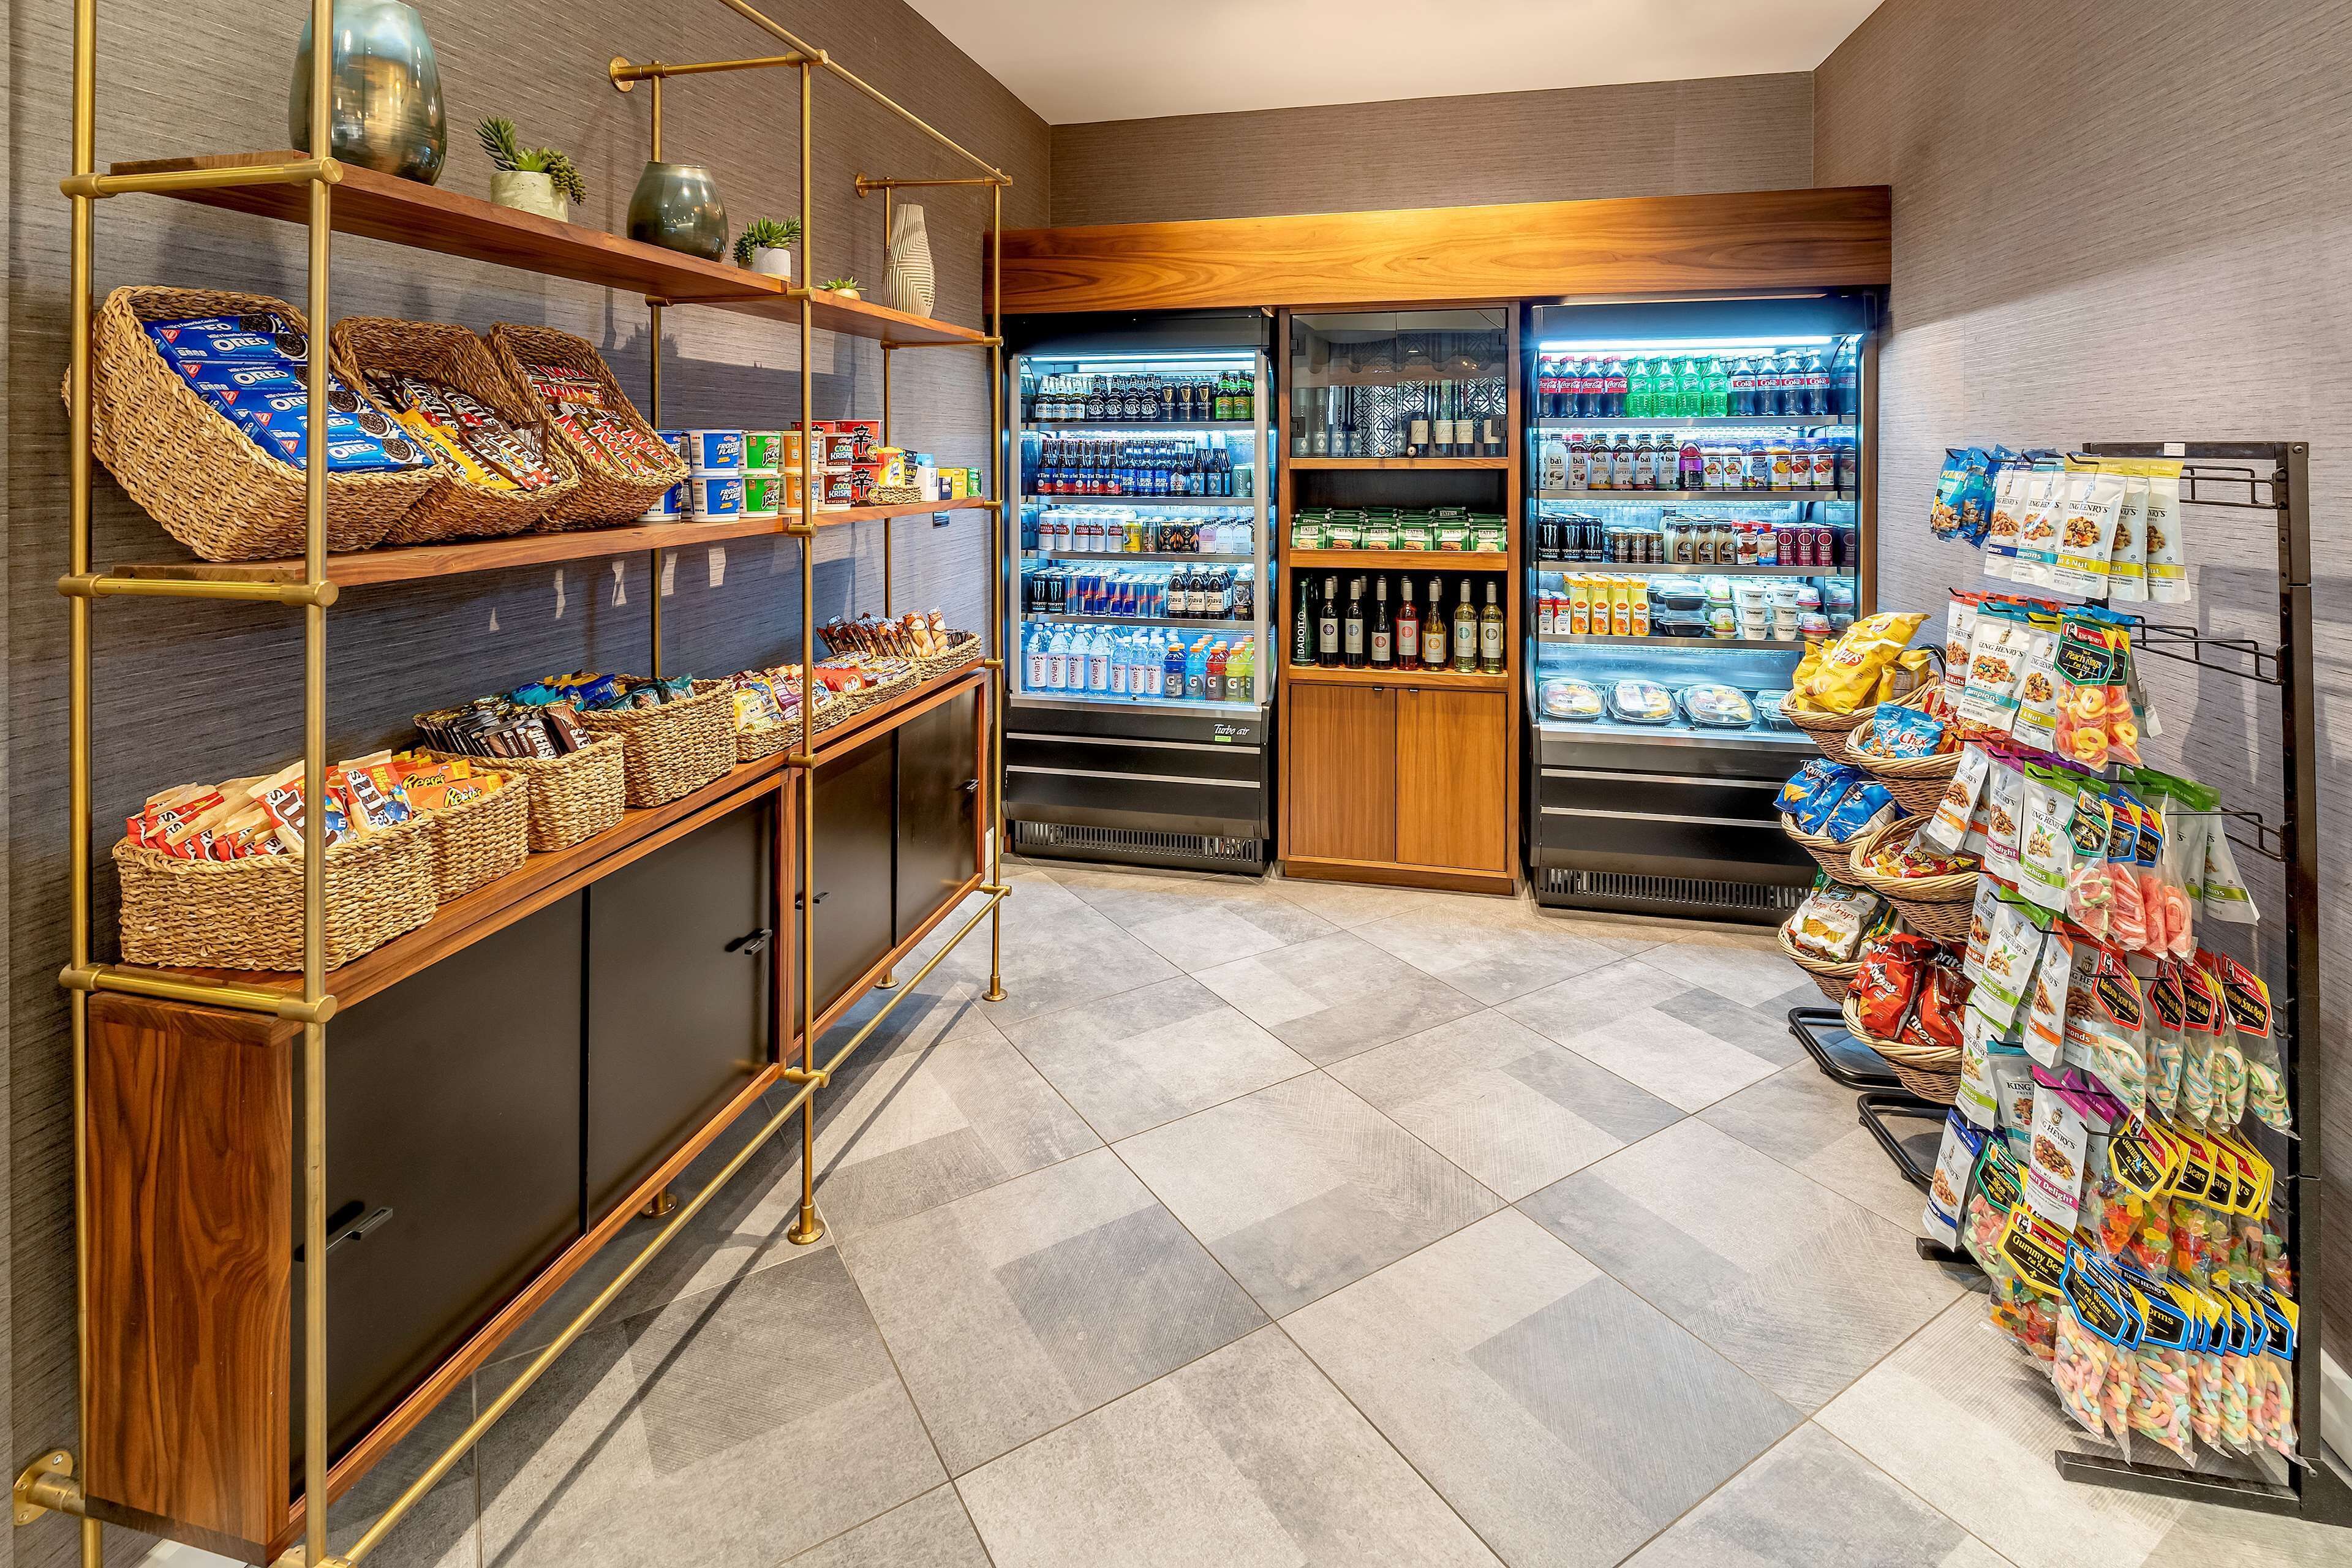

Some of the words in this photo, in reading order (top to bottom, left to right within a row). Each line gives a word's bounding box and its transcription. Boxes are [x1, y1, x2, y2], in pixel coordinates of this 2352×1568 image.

[213, 337, 270, 352] OREO
[233, 370, 289, 385] OREO
[1088, 404, 1104, 413] 805
[1107, 404, 1122, 413] 805
[1125, 404, 1140, 413] 805
[1141, 404, 1156, 412] 805
[853, 424, 873, 455] 辛
[328, 443, 379, 459] OREO
[589, 425, 638, 476] TWIX
[852, 468, 874, 499] 辛
[2071, 558, 2088, 569] Nut
[1995, 645, 2024, 658] HENRY'S
[2065, 650, 2086, 663] Peach
[2086, 655, 2103, 669] Rings
[1950, 676, 1965, 685] Nuts
[2027, 713, 2041, 722] Nut
[1214, 724, 1236, 735] Turbo
[1899, 732, 1929, 747] Chex
[1829, 902, 1857, 921] Crisps
[1971, 952, 1984, 962] Mix
[2082, 962, 2092, 971] KH
[2100, 978, 2117, 1001] Rainbow
[2117, 992, 2128, 1008] Sour
[2128, 1000, 2139, 1017] Belts
[2198, 1000, 2209, 1017] Belts
[2242, 998, 2254, 1014] Sour
[2254, 1006, 2265, 1022] Belts
[2007, 1082, 2029, 1091] KING
[2046, 1124, 2076, 1150] HENRY'S
[2147, 1140, 2163, 1159] HENRY'S
[2139, 1159, 2157, 1182] Bears
[2186, 1164, 2206, 1183] Bears
[2043, 1180, 2073, 1205] Delight
[2012, 1234, 2046, 1262] Gummy
[2045, 1237, 2067, 1256] HENRY'S
[2027, 1256, 2037, 1265] Fat
[2035, 1262, 2049, 1274] Free
[2087, 1264, 2098, 1277] KING
[2124, 1271, 2141, 1285] KING
[2141, 1278, 2168, 1297] HENRY'S
[2074, 1273, 2092, 1293] Neon
[2092, 1289, 2117, 1321] Worms
[2089, 1300, 2102, 1314] Free
